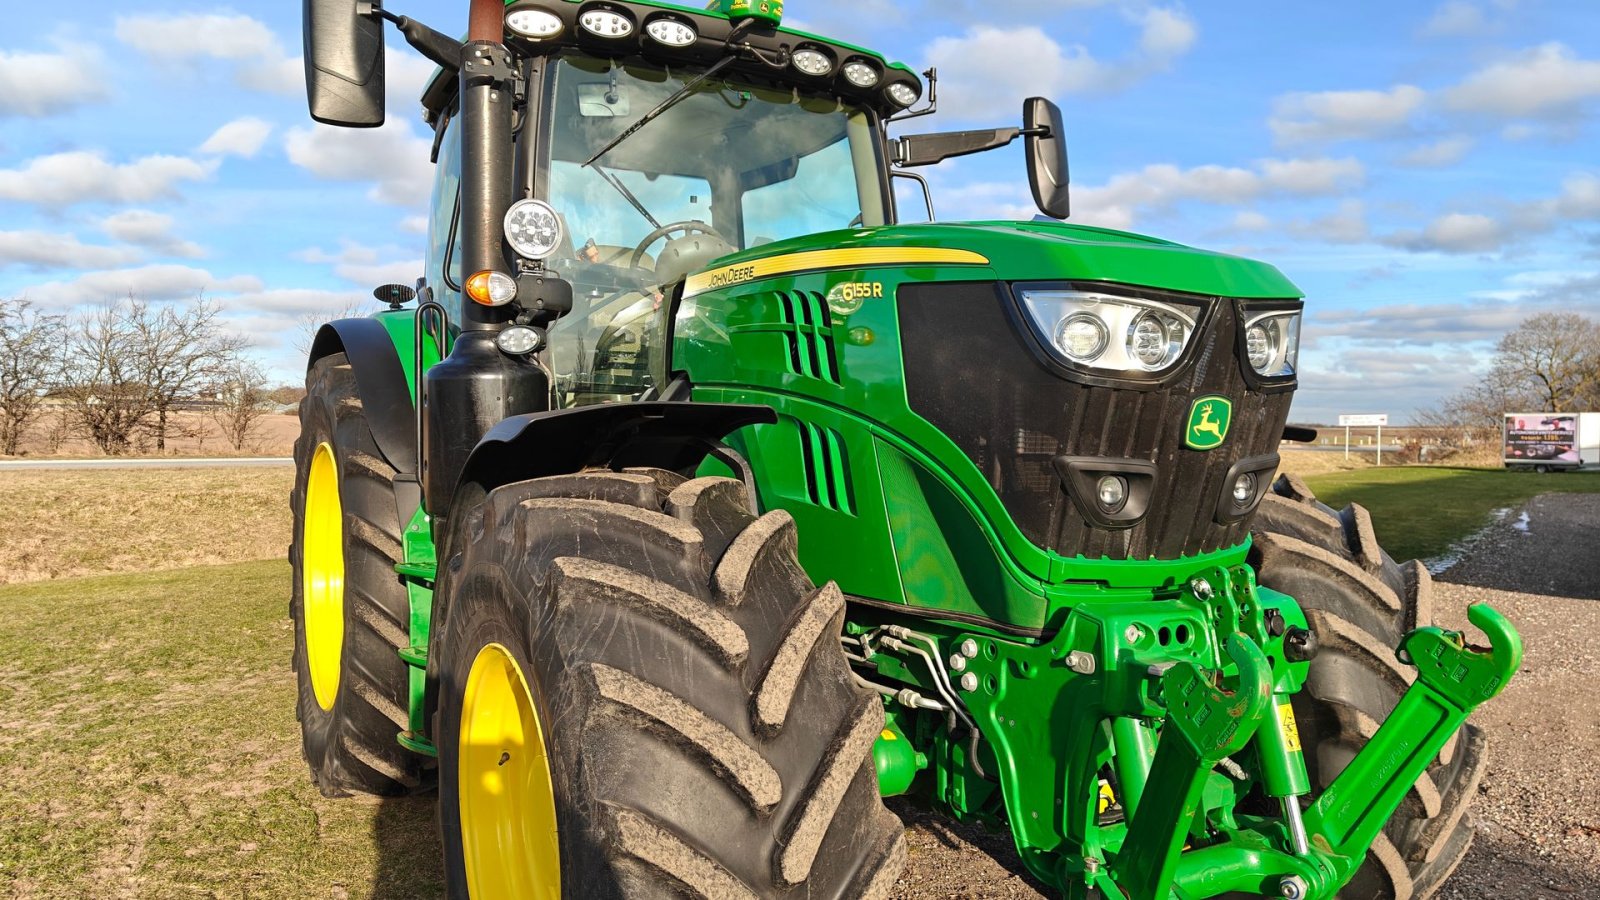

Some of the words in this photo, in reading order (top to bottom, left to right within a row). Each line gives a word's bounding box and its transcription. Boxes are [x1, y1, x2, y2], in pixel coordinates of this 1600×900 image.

[708, 273, 728, 288] JOHN
[728, 266, 755, 283] DEERE
[842, 283, 871, 301] 6155
[873, 282, 883, 297] R
